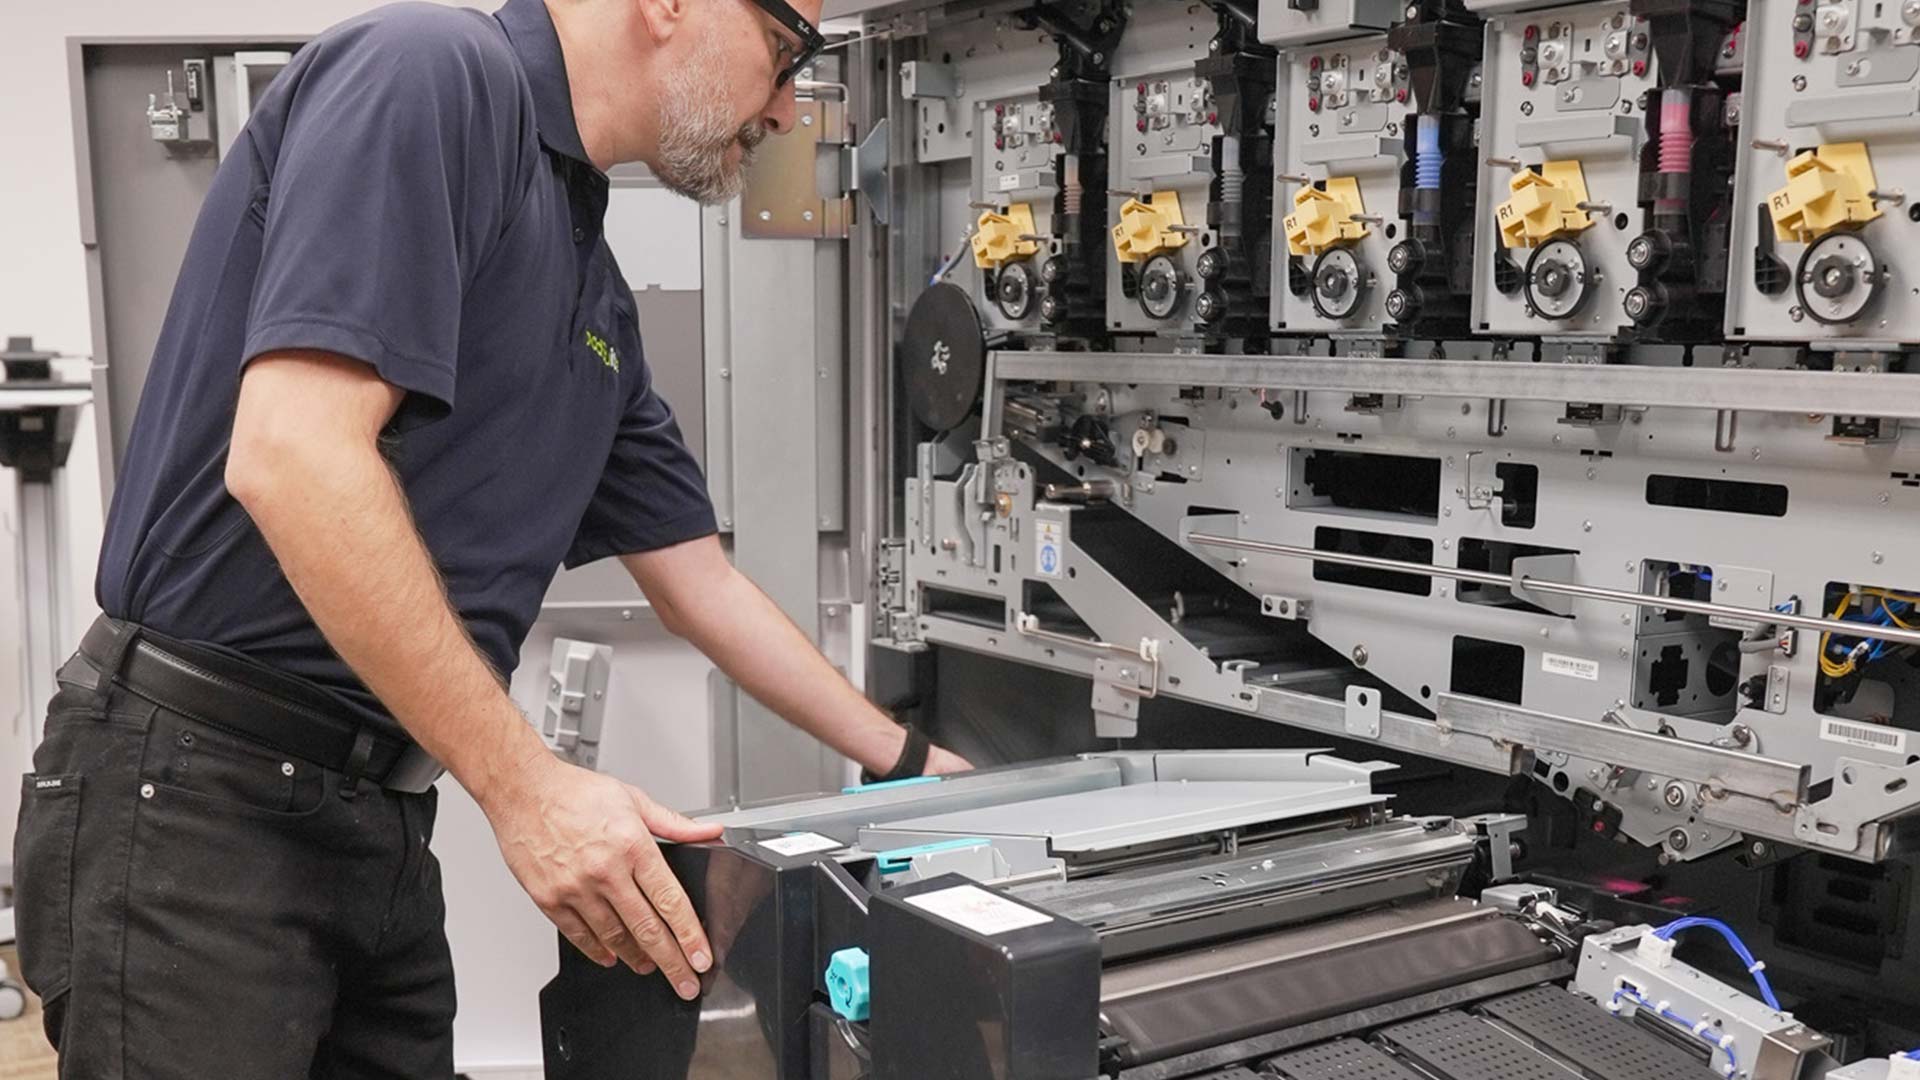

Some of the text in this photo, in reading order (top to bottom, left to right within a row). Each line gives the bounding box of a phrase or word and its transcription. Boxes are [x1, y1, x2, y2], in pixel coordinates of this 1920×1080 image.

[1773, 192, 1791, 211] R1
[1499, 204, 1514, 220] R1
[1286, 216, 1297, 231] R1
